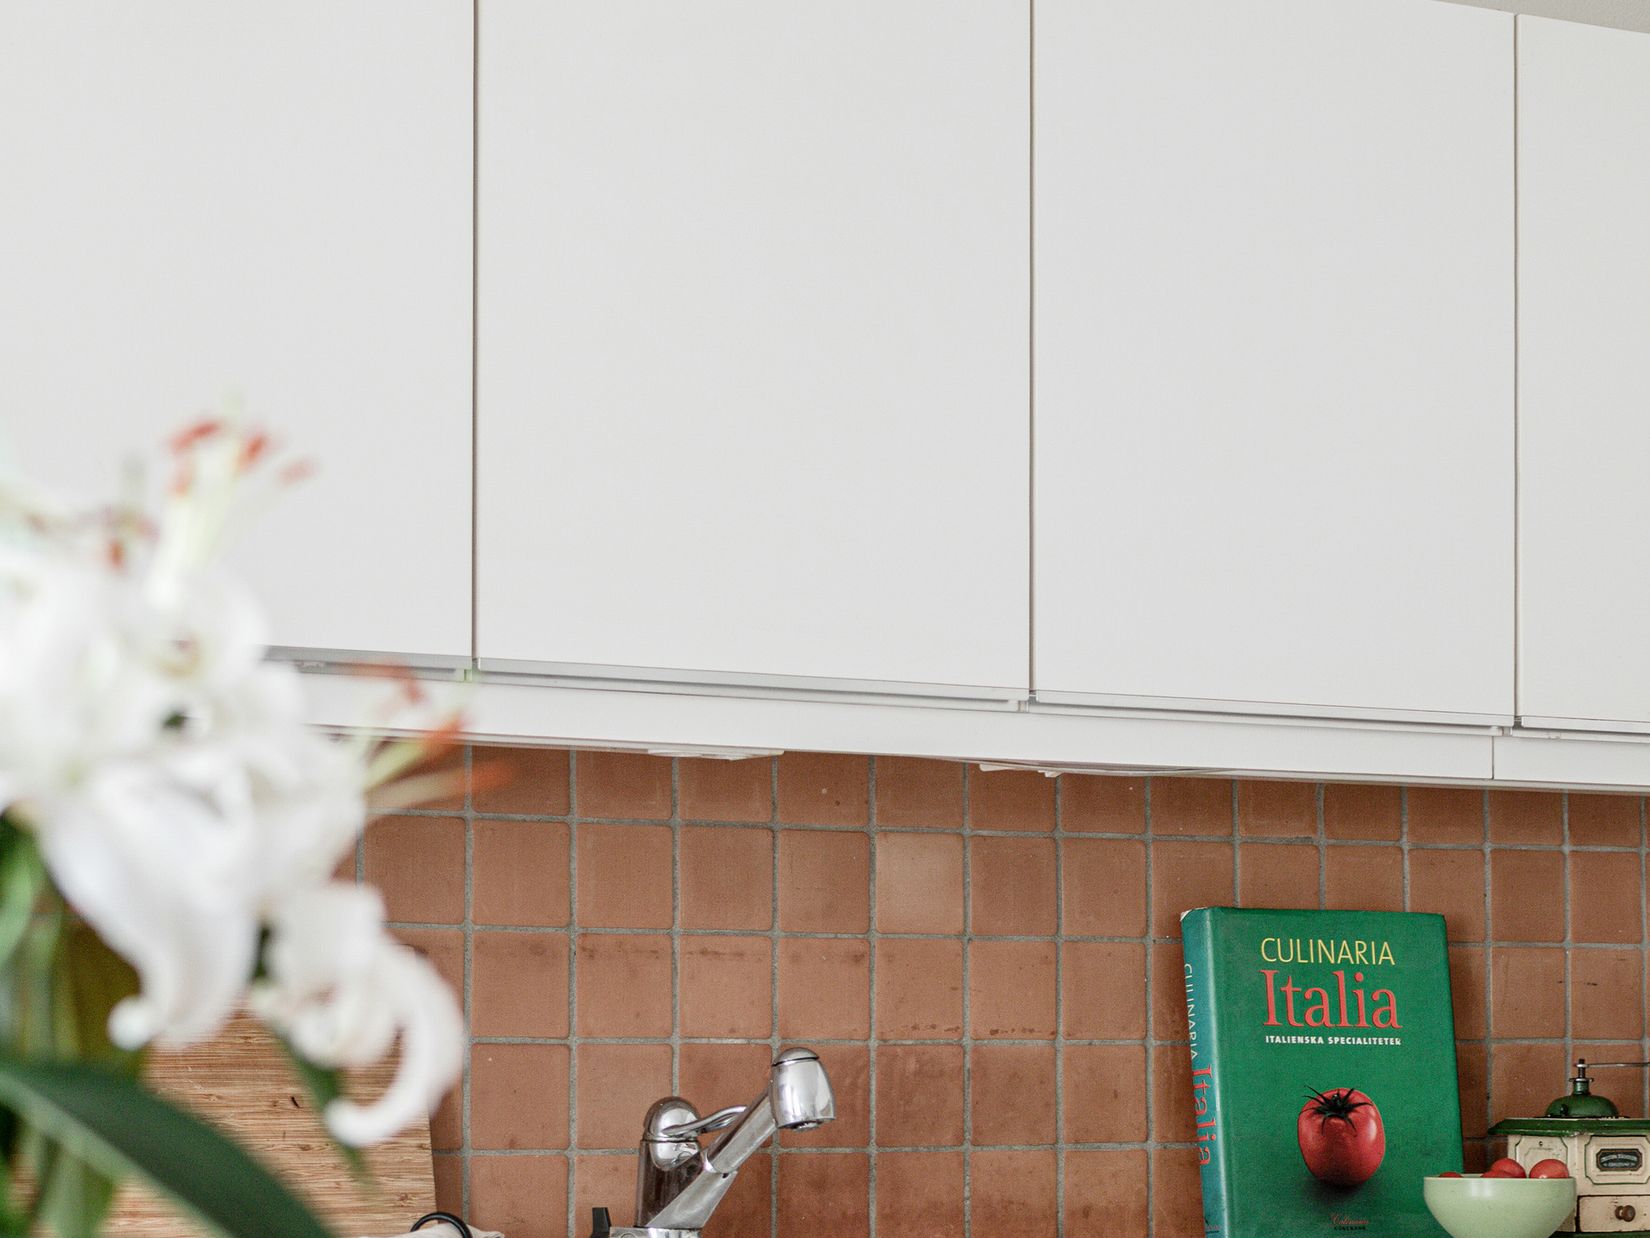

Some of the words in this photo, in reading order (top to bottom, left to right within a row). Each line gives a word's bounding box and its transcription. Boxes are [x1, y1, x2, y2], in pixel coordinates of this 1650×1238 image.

[1261, 937, 1396, 966] CULINARIA
[1258, 969, 1403, 1029] Italia
[1265, 1035, 1325, 1045] ITALIENSKA
[1327, 1036, 1402, 1046] SPECIALITETER
